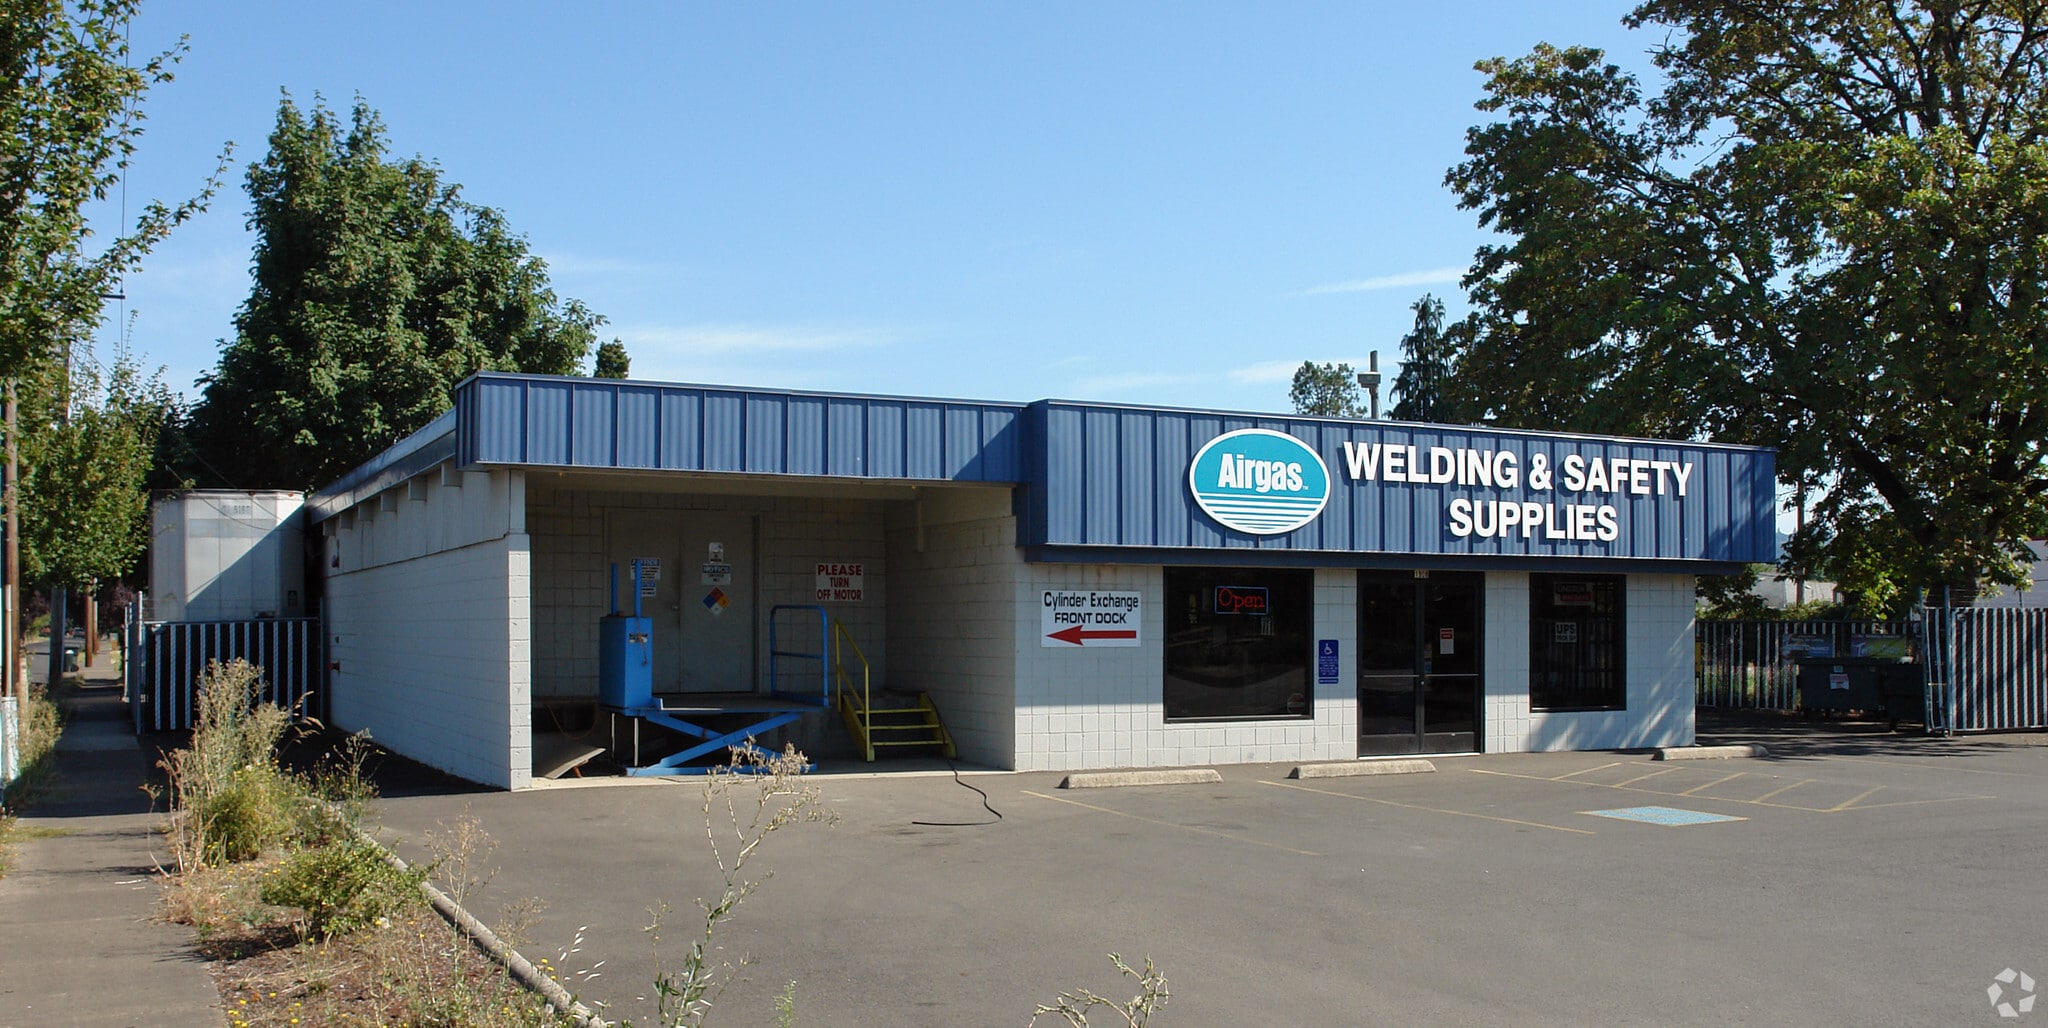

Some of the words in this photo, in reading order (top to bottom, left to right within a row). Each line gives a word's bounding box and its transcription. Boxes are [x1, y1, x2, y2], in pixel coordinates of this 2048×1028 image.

[1217, 453, 1303, 492] Airgas
[1343, 441, 1518, 488] WELDING
[1529, 453, 1553, 490] &
[1564, 454, 1693, 497] SAFETY
[1449, 498, 1619, 541] SUPPLIES
[817, 564, 863, 576] PLEASE
[829, 577, 850, 588] TURN
[817, 589, 832, 601] OFF
[833, 589, 863, 601] MOTOR
[1043, 591, 1086, 609] Cylinder
[1090, 592, 1139, 612] Exchange
[1218, 587, 1265, 612] Open
[1054, 612, 1092, 624] FRONT
[1095, 612, 1127, 625] DOCK
[1556, 623, 1576, 634] UPS
